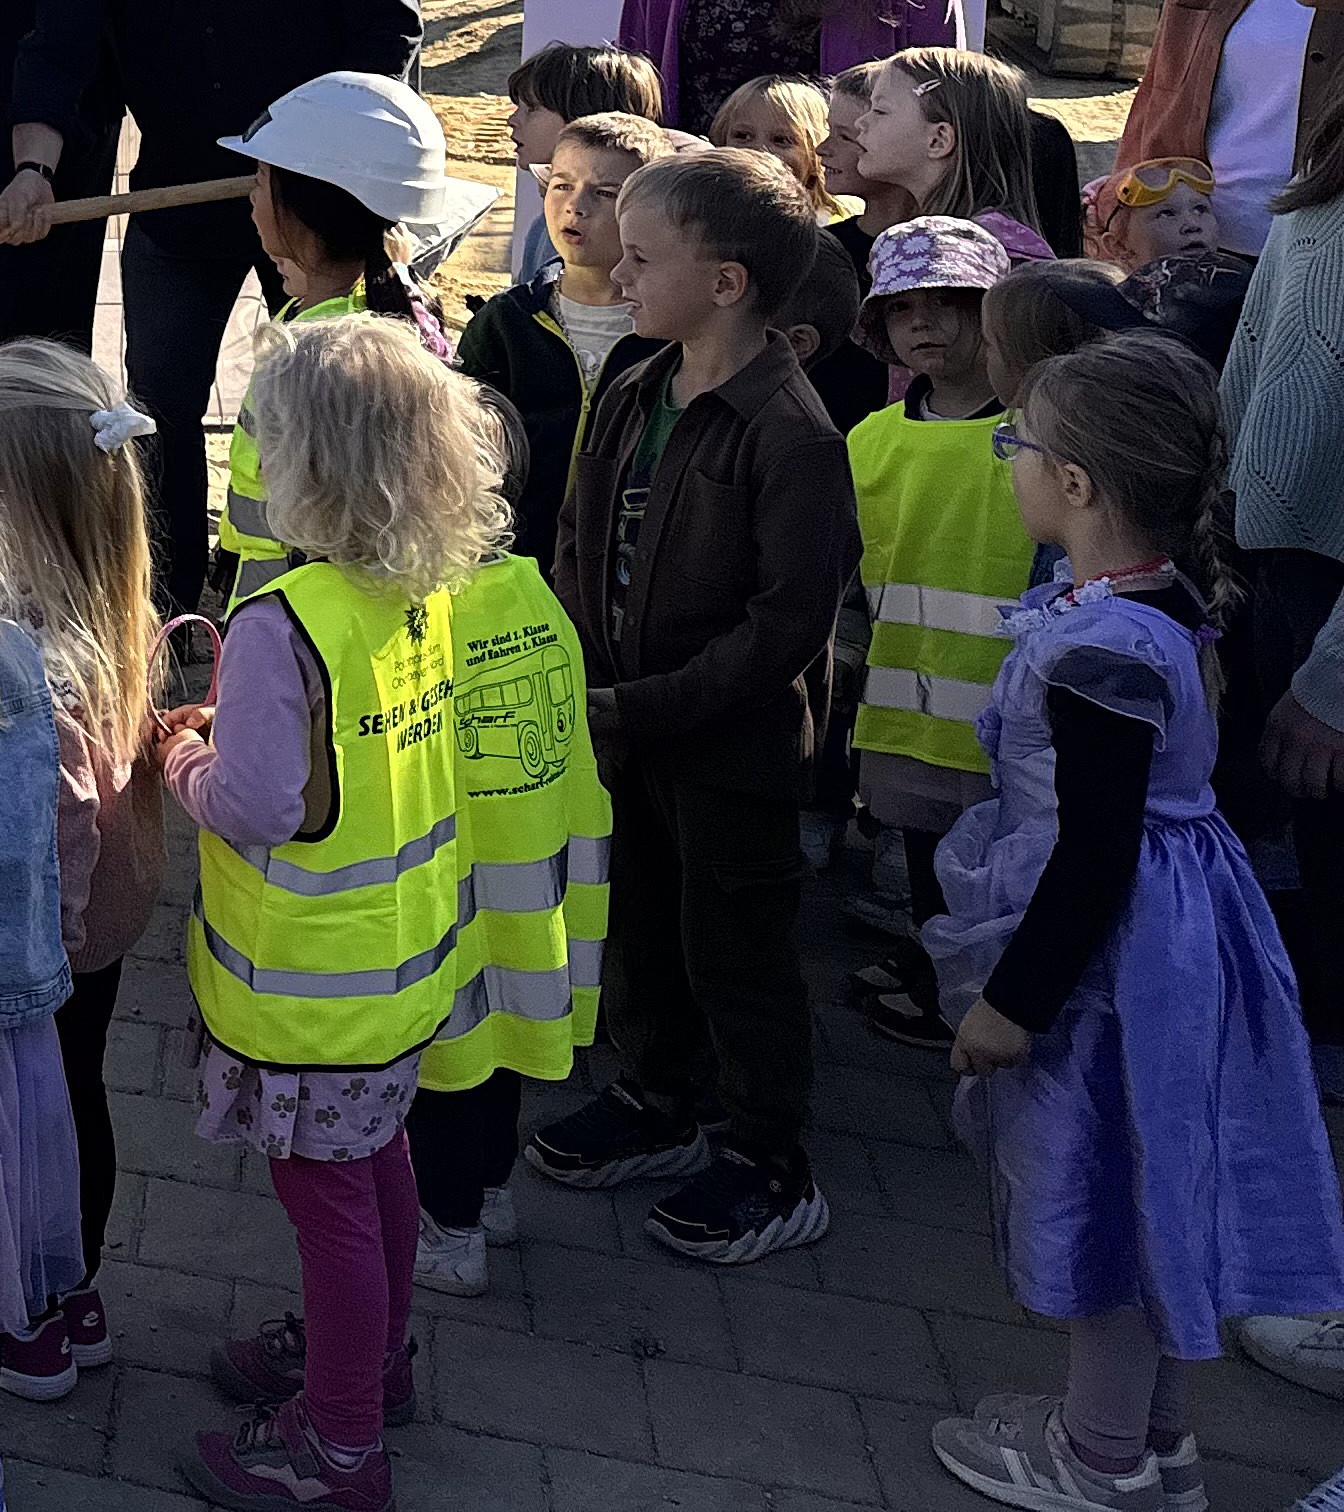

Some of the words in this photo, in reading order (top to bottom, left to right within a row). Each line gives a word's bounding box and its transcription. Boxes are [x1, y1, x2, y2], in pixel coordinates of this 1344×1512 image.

[466, 639, 490, 653] Wir
[491, 631, 512, 647] sind
[522, 622, 550, 638] Klasse
[465, 651, 487, 667] und
